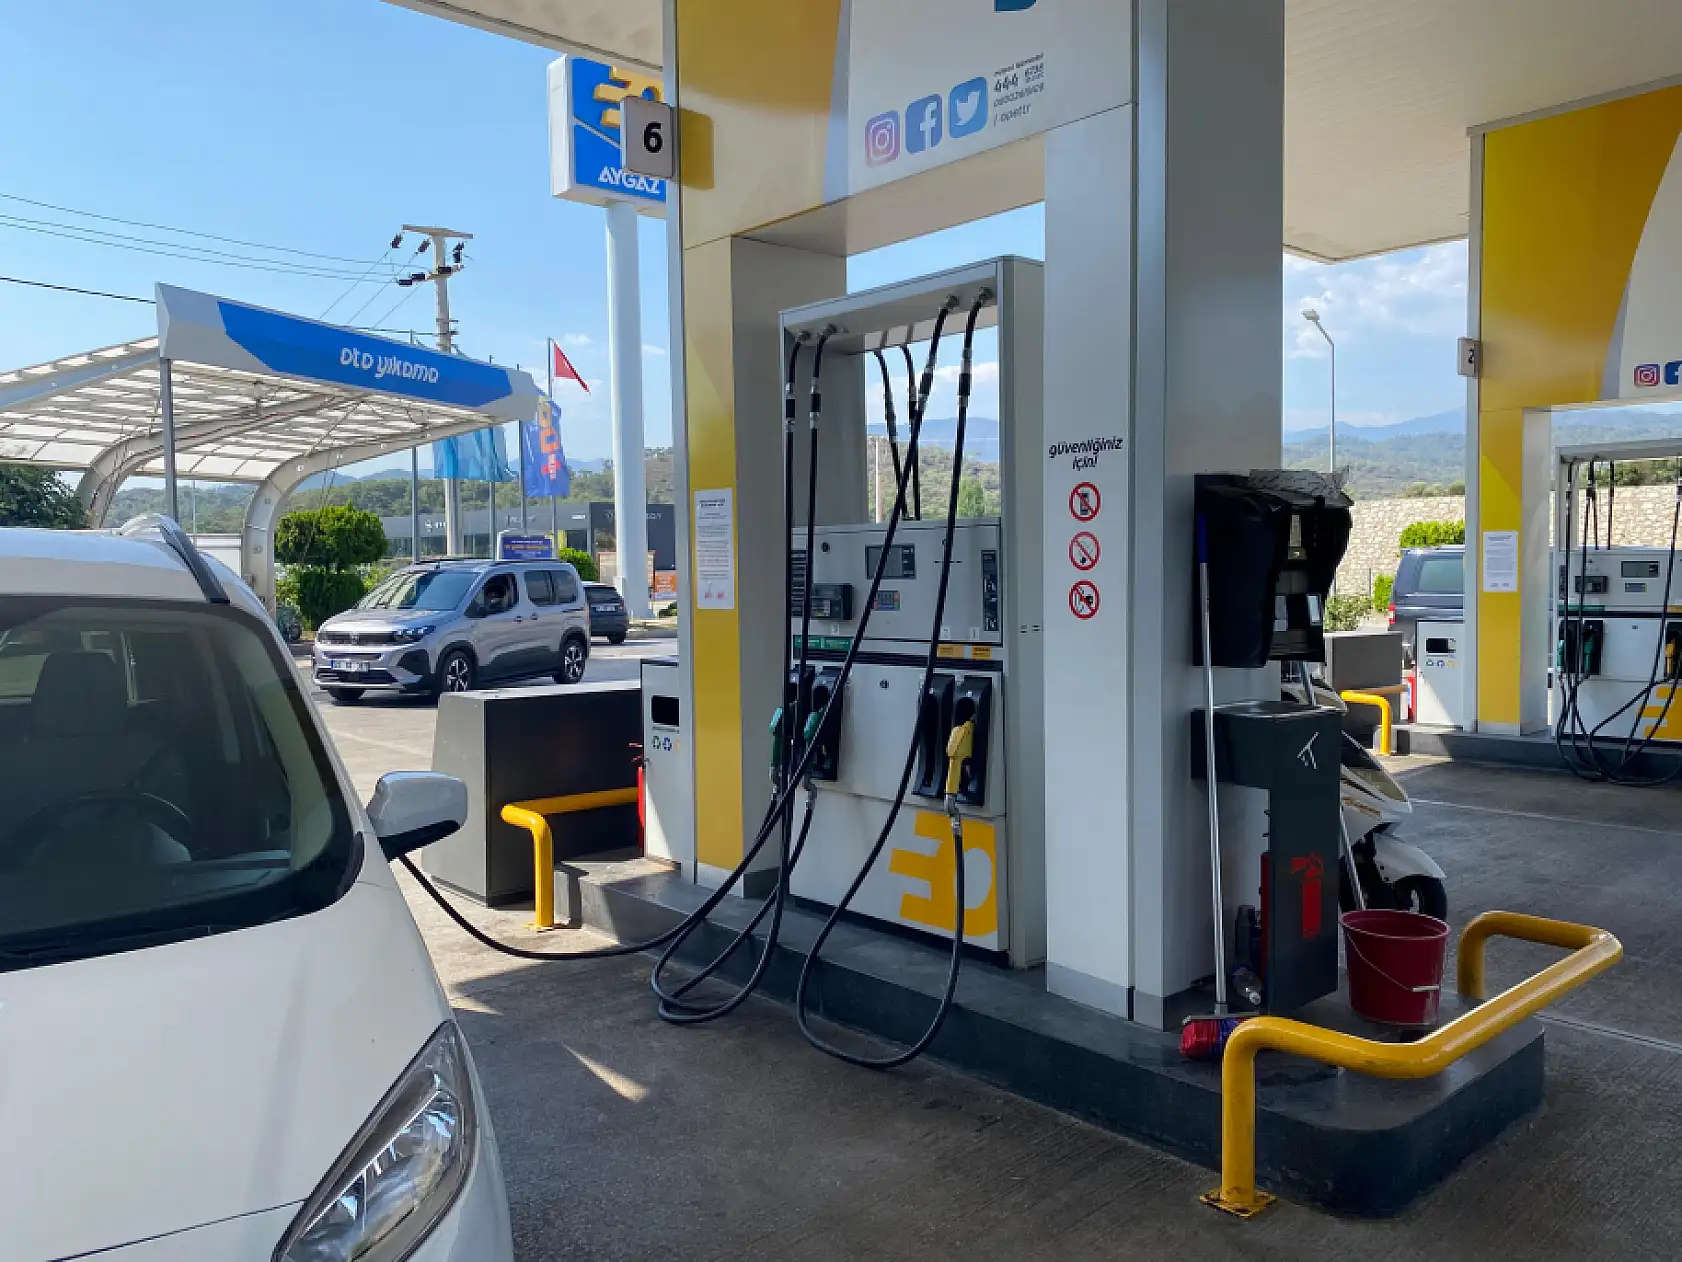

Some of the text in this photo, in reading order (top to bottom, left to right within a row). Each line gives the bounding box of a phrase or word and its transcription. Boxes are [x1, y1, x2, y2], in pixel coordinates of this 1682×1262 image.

[643, 121, 663, 154] 6
[598, 165, 662, 196] AYGAZ
[340, 347, 374, 370] oto
[1048, 435, 1124, 459] güvenliğiniz
[1072, 455, 1099, 472] için!
